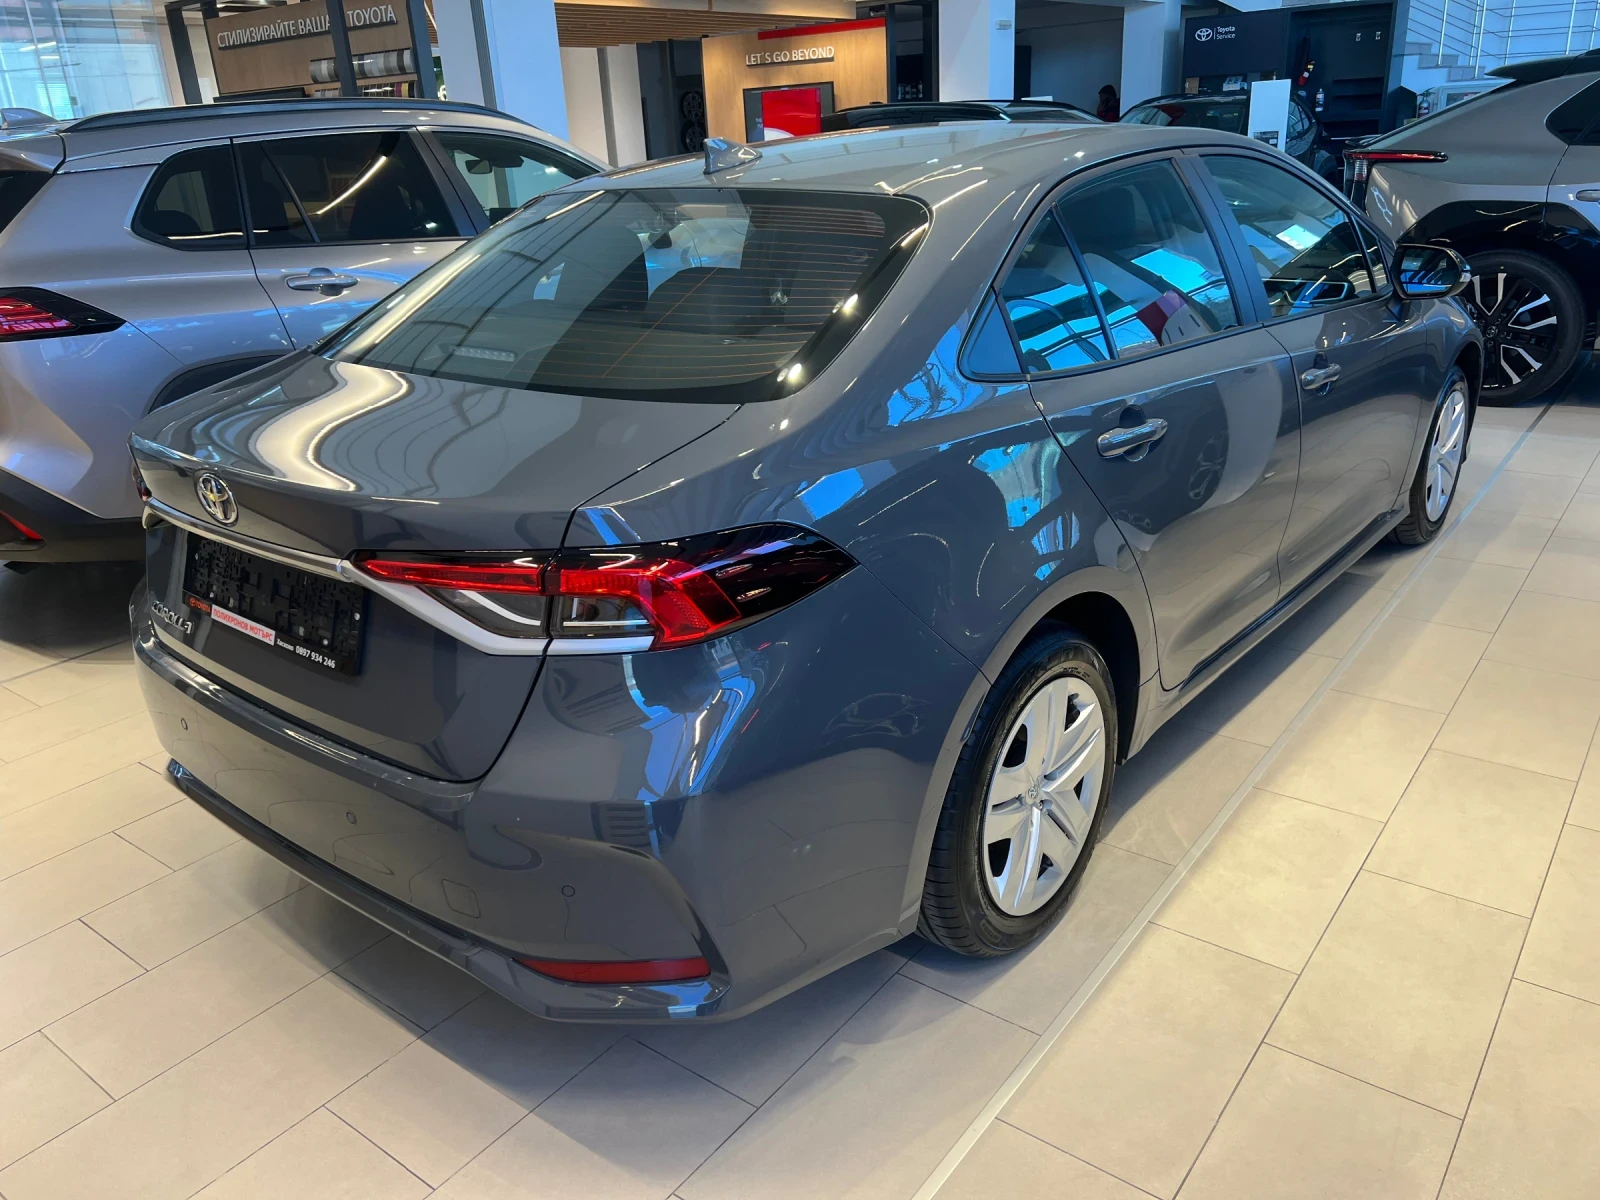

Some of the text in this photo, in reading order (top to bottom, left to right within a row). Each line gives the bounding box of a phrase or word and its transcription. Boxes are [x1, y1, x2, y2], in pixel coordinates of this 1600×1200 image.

[217, 19, 297, 47] СТИЛИЗИРАЙТЕ
[347, 4, 397, 27] TOYOTA
[773, 51, 789, 62] GO
[792, 46, 834, 60] BEYOND
[213, 608, 249, 631] ПОЛИХРОНОВ
[249, 625, 274, 642] МОТЪРС
[295, 645, 311, 658] 0897
[310, 651, 323, 664] 934
[323, 656, 336, 669] 246
